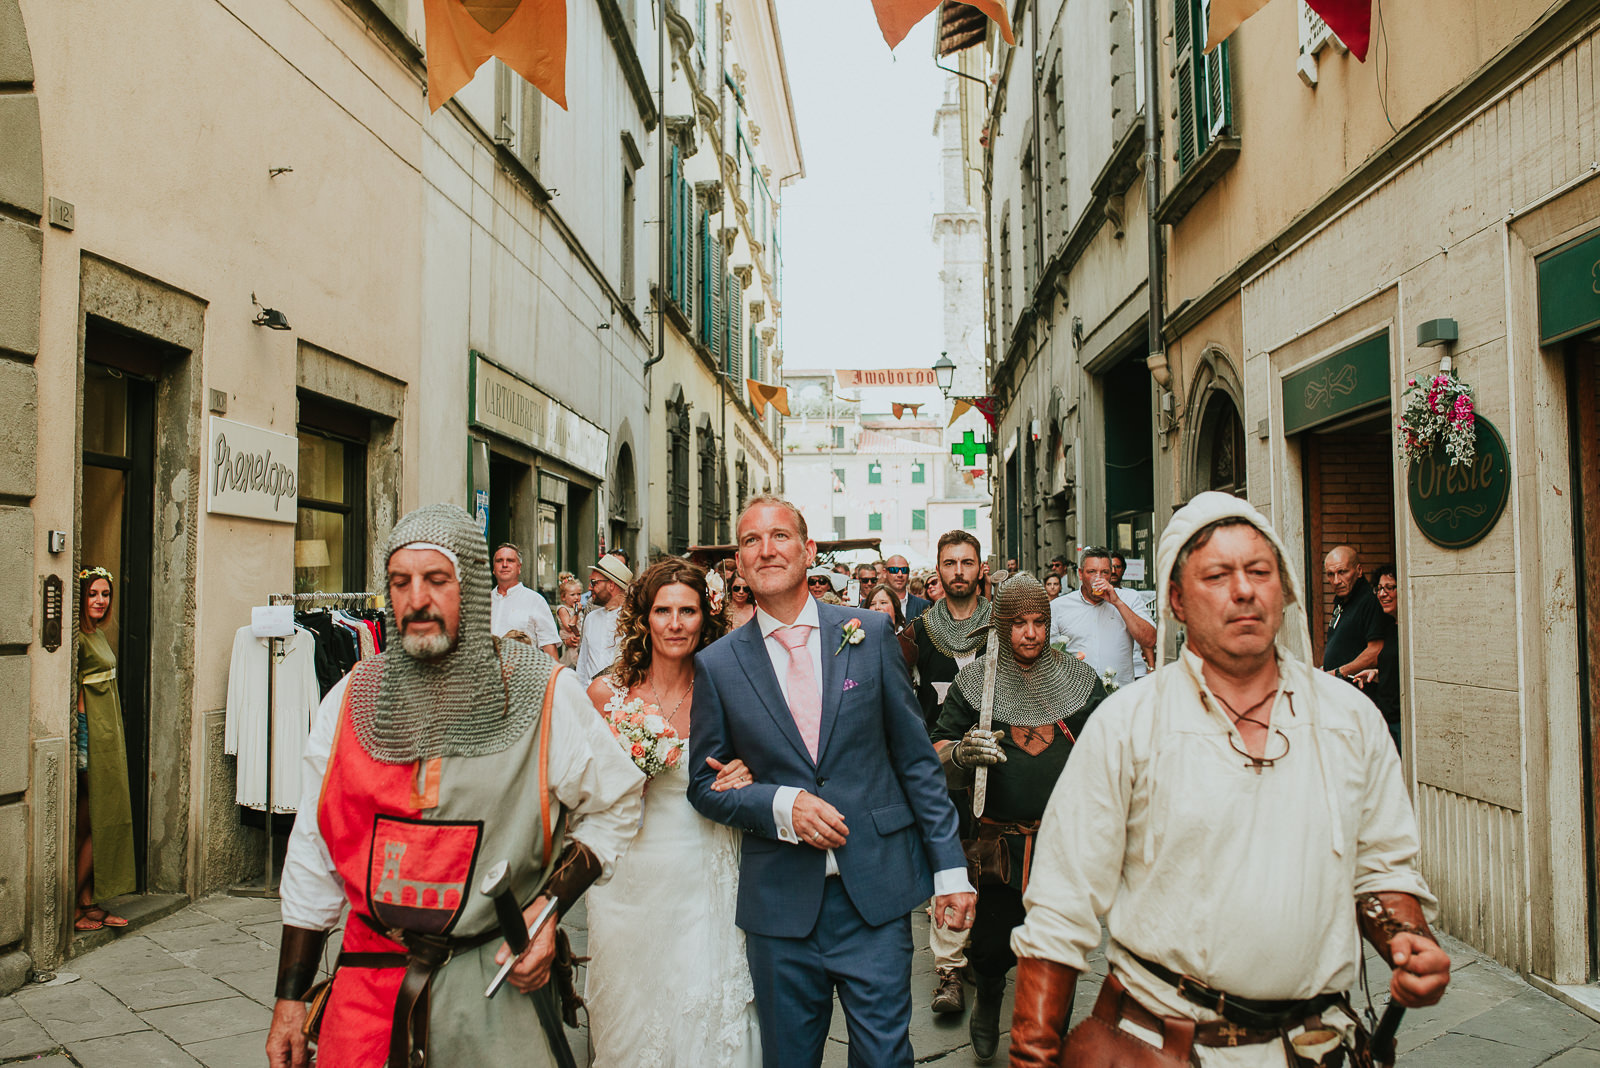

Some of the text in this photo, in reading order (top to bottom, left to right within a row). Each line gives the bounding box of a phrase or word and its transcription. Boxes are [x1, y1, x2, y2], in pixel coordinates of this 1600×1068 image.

[60, 205, 70, 223] 12
[484, 377, 545, 438] CARTOLIBRERIA
[1418, 453, 1493, 499] Oreste
